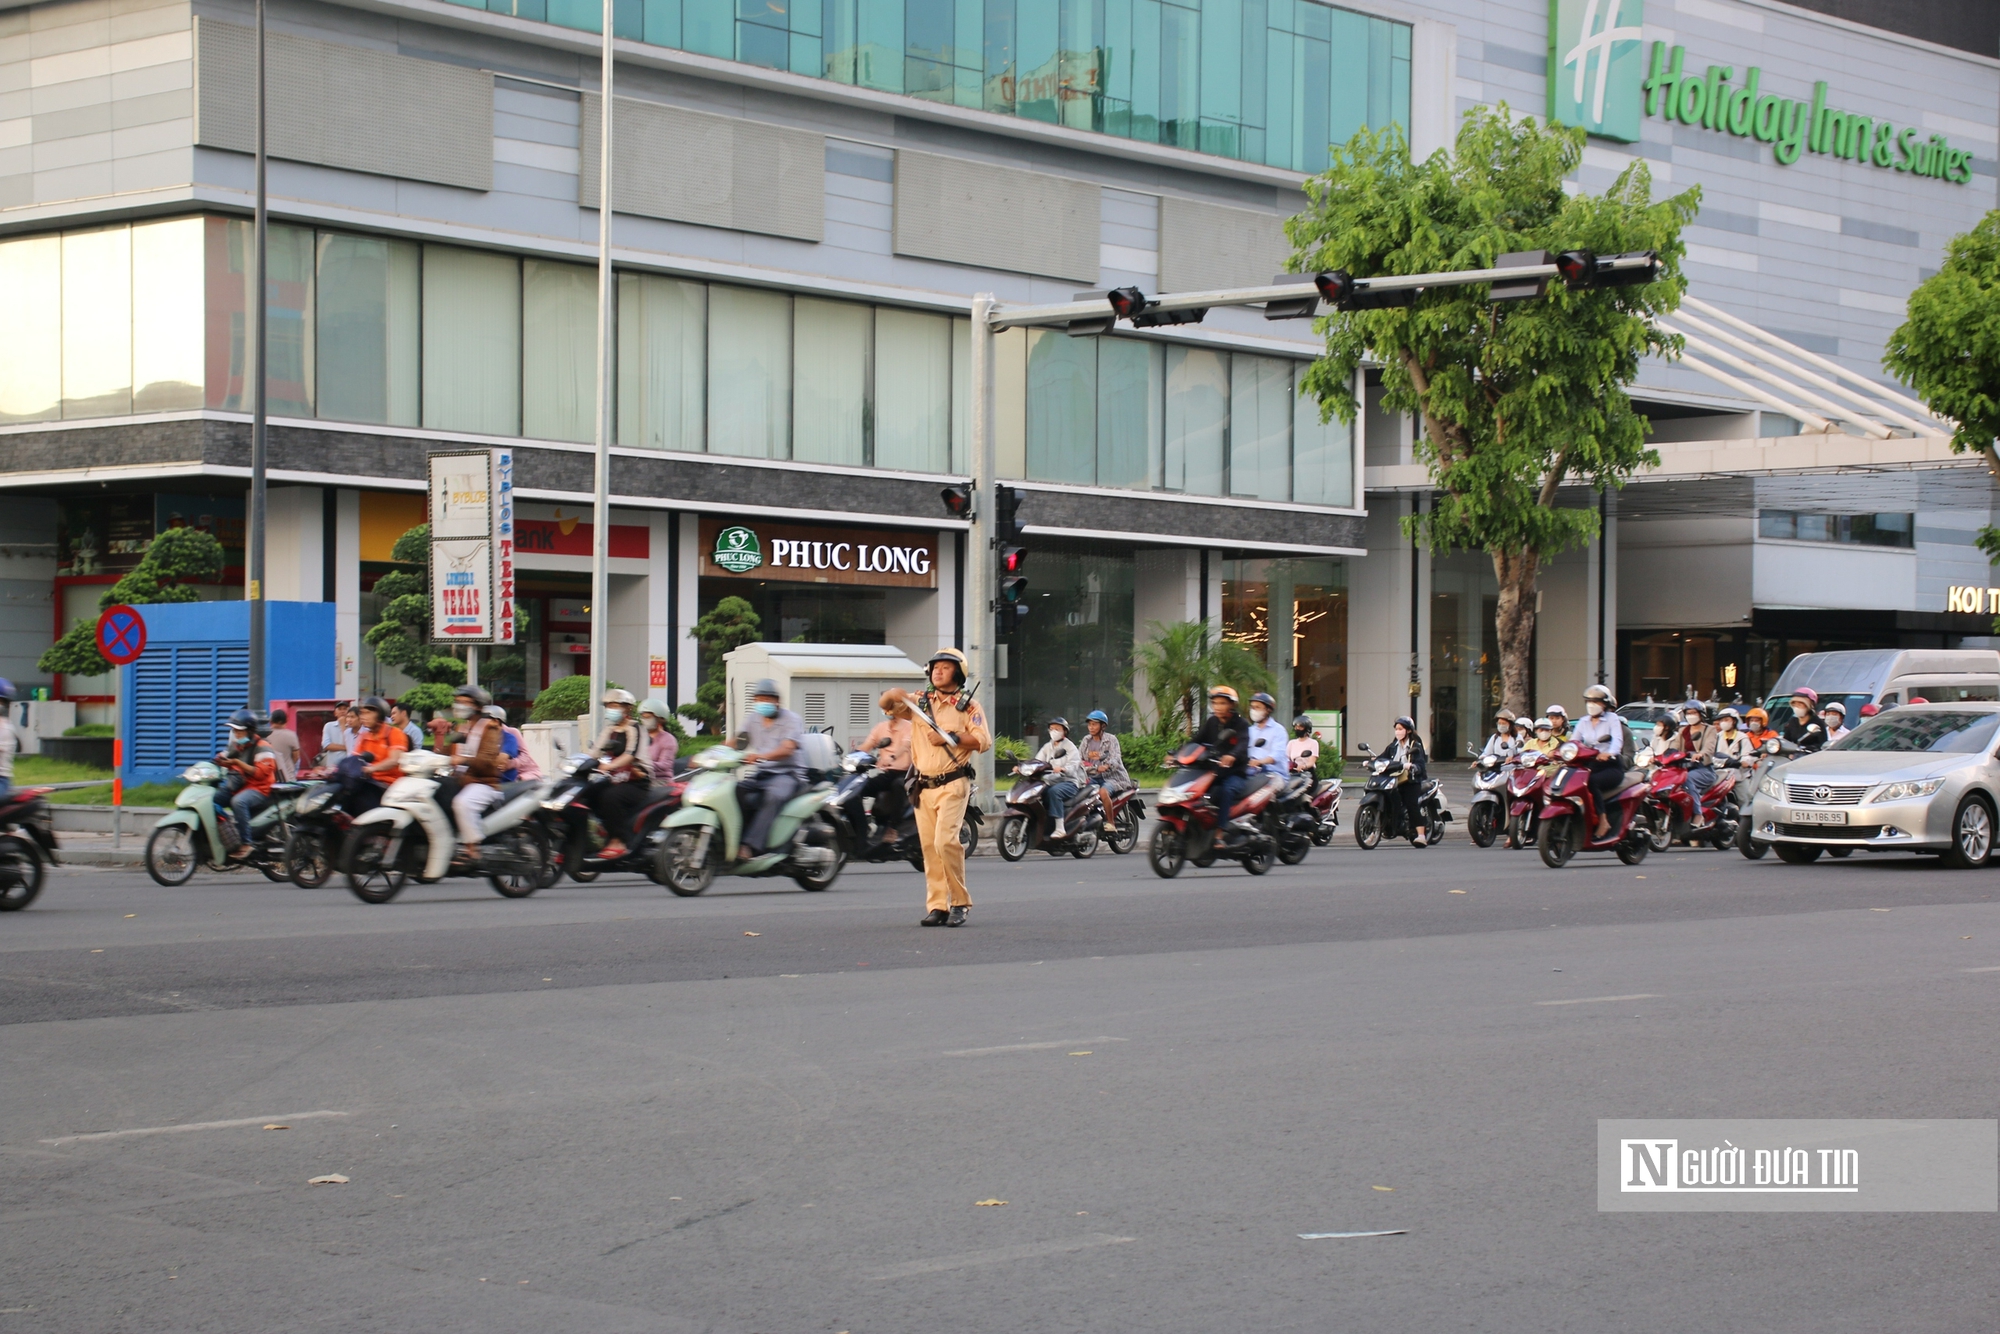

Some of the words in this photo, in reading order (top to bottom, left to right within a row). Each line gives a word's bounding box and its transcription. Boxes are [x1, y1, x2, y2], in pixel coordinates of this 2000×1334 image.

[1643, 40, 1807, 165] Holiday
[1808, 80, 1872, 163] Inn
[1873, 121, 1895, 168] &
[1895, 127, 1974, 185] Suites
[498, 453, 512, 535] BYBLOS
[515, 526, 555, 550] ank
[715, 552, 739, 562] PHUC
[739, 553, 762, 565] LONG
[771, 538, 850, 571] PHUC
[857, 544, 931, 575] LONG
[443, 588, 480, 616] TEXAS
[499, 539, 514, 640] TEXAS
[1947, 585, 1983, 614] KOI
[1986, 587, 2000, 615] T
[1795, 811, 1842, 823] 51A-186.95
